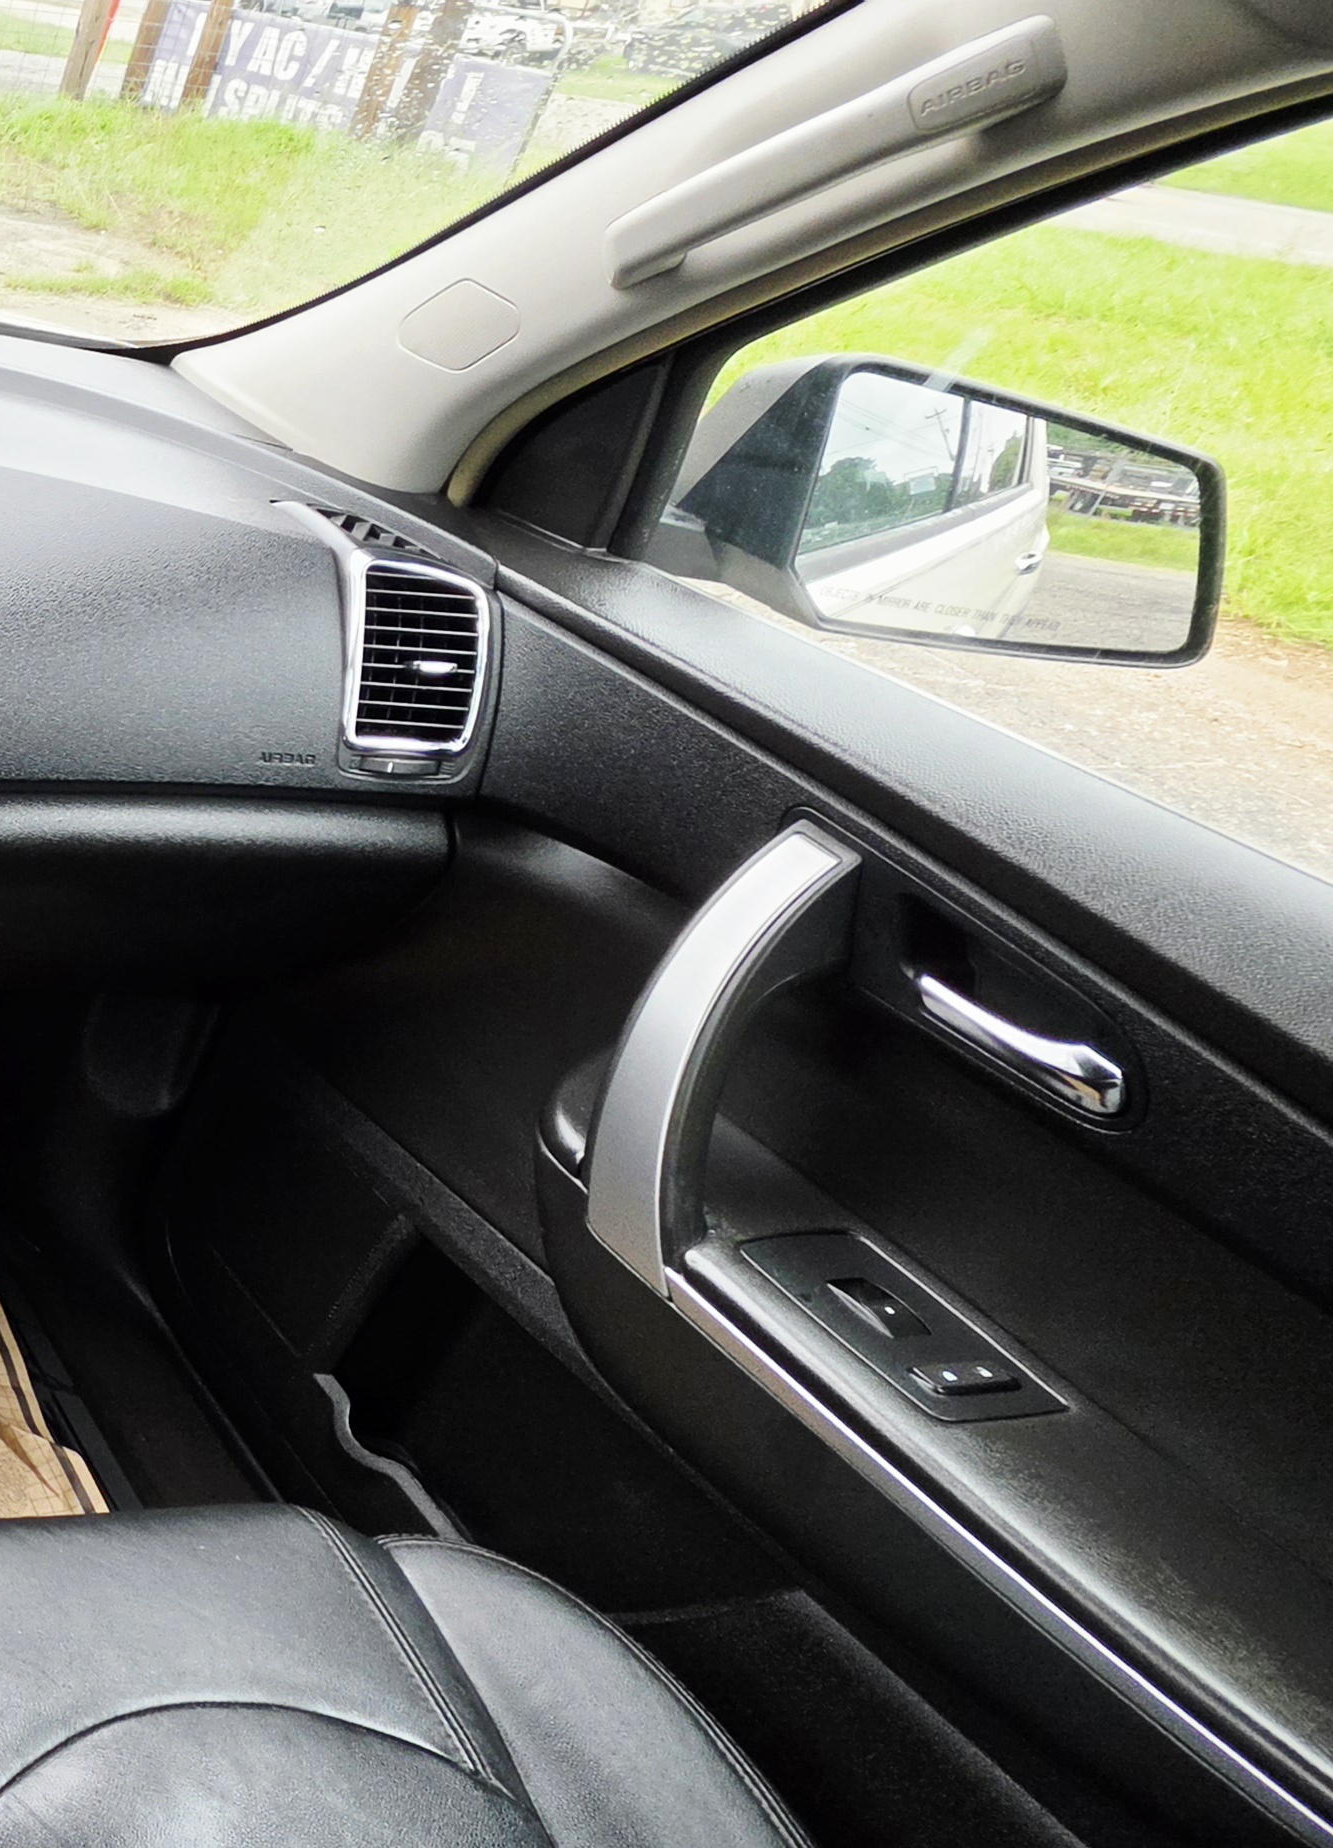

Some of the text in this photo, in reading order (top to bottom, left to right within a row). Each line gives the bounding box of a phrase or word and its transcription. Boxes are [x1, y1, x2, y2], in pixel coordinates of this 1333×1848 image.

[248, 27, 307, 81] AC
[920, 59, 1027, 117] AIRBAG
[819, 587, 859, 601] OBJECTS
[877, 594, 912, 610] MIRROR
[914, 600, 931, 613] ARE
[934, 603, 969, 618] CLOSER
[973, 608, 997, 622] THAN
